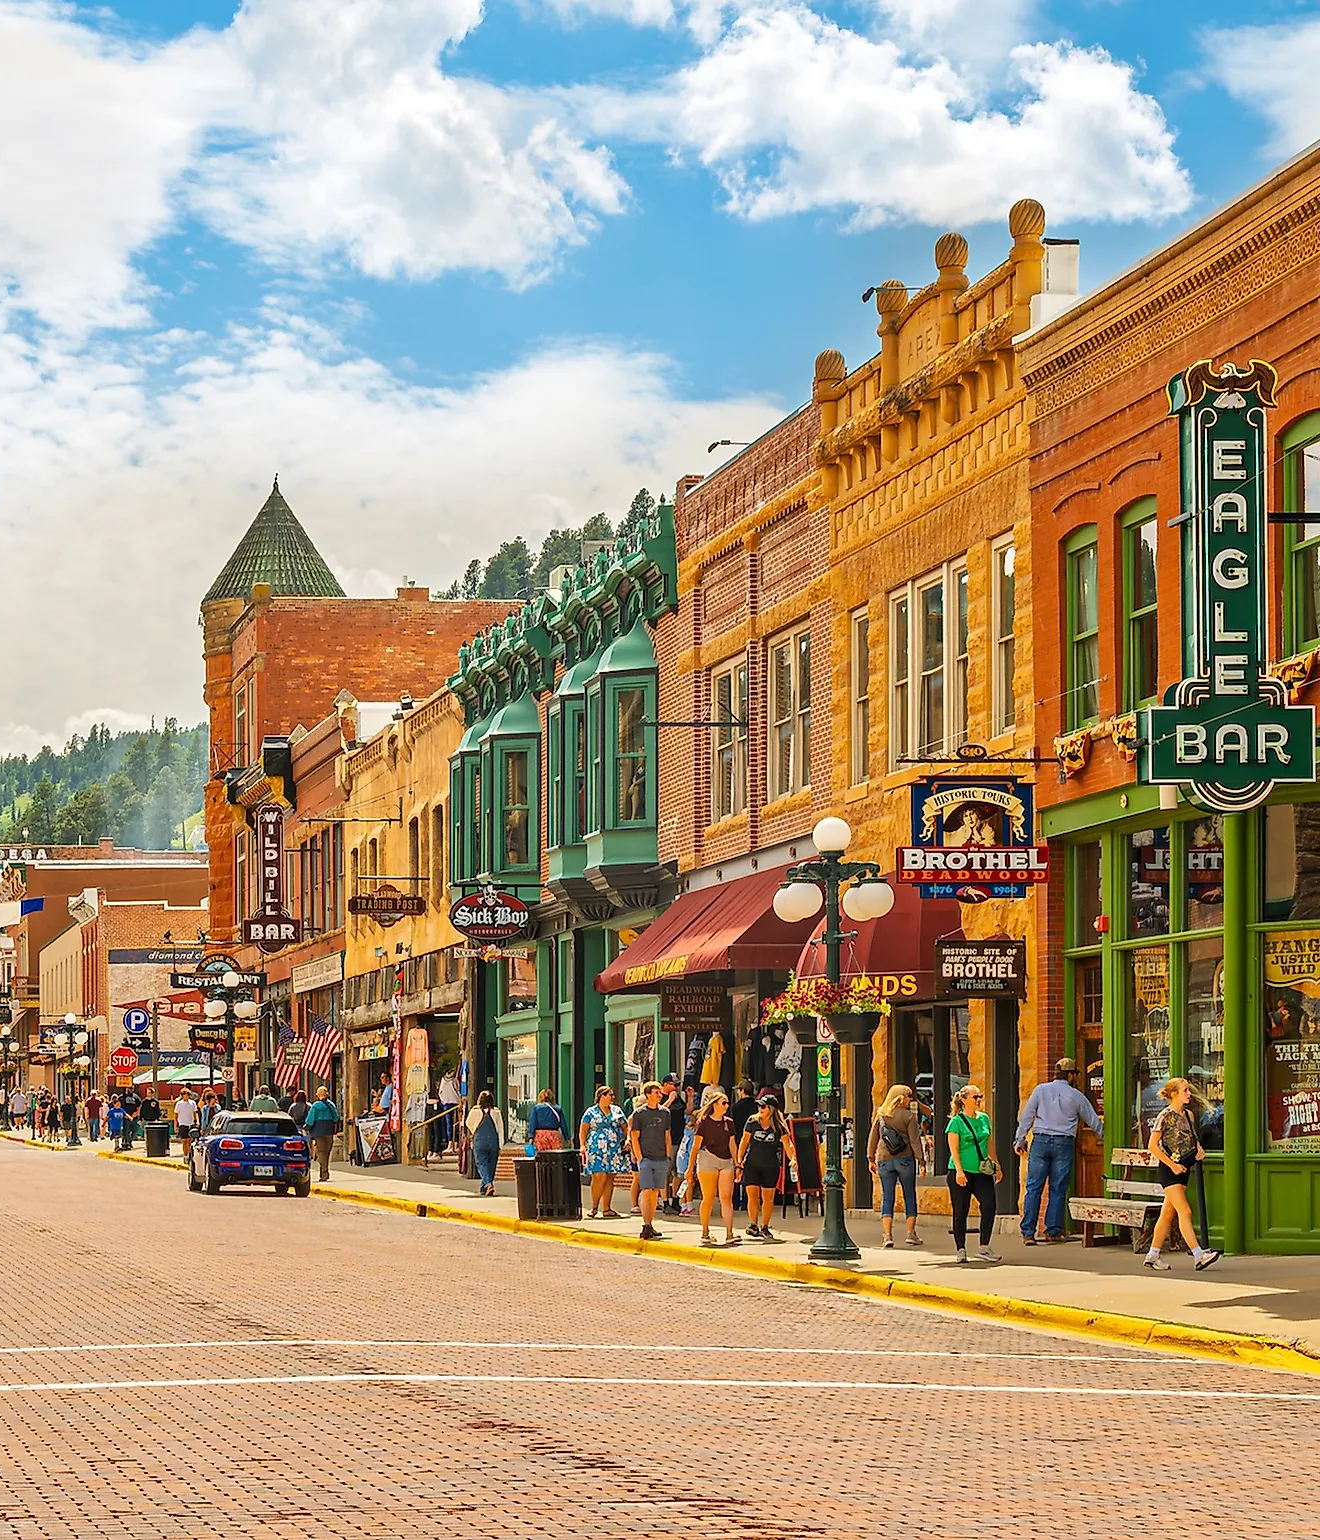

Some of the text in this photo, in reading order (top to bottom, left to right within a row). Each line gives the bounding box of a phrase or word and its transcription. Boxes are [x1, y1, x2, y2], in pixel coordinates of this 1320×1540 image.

[1212, 439, 1250, 696] EAGLE
[1176, 723, 1292, 763] BAR
[933, 789, 1012, 808] HISTORIC TOURS
[264, 811, 278, 860] WILD
[902, 848, 1047, 869] BROTHEL
[902, 870, 1046, 880] DEADWOOD
[265, 866, 278, 916] BILL
[929, 885, 952, 893] 1876
[356, 900, 418, 910] TRADING POST
[453, 905, 529, 927] Sick Boy
[250, 924, 295, 940] BAR
[148, 951, 194, 960] diamond
[942, 963, 1018, 977] BROTHEL
[177, 974, 260, 987] RESTAUANT
[665, 986, 723, 994] DEADWOOD
[668, 995, 720, 1003] RAILROAD
[674, 1004, 714, 1013] EXHIBIT
[131, 1011, 145, 1030] P
[1274, 1044, 1299, 1053] THE
[112, 1055, 136, 1066] STOP
[158, 1054, 184, 1063] been
[1276, 1052, 1308, 1061] JACK
[1288, 1101, 1319, 1126] RIGHT
